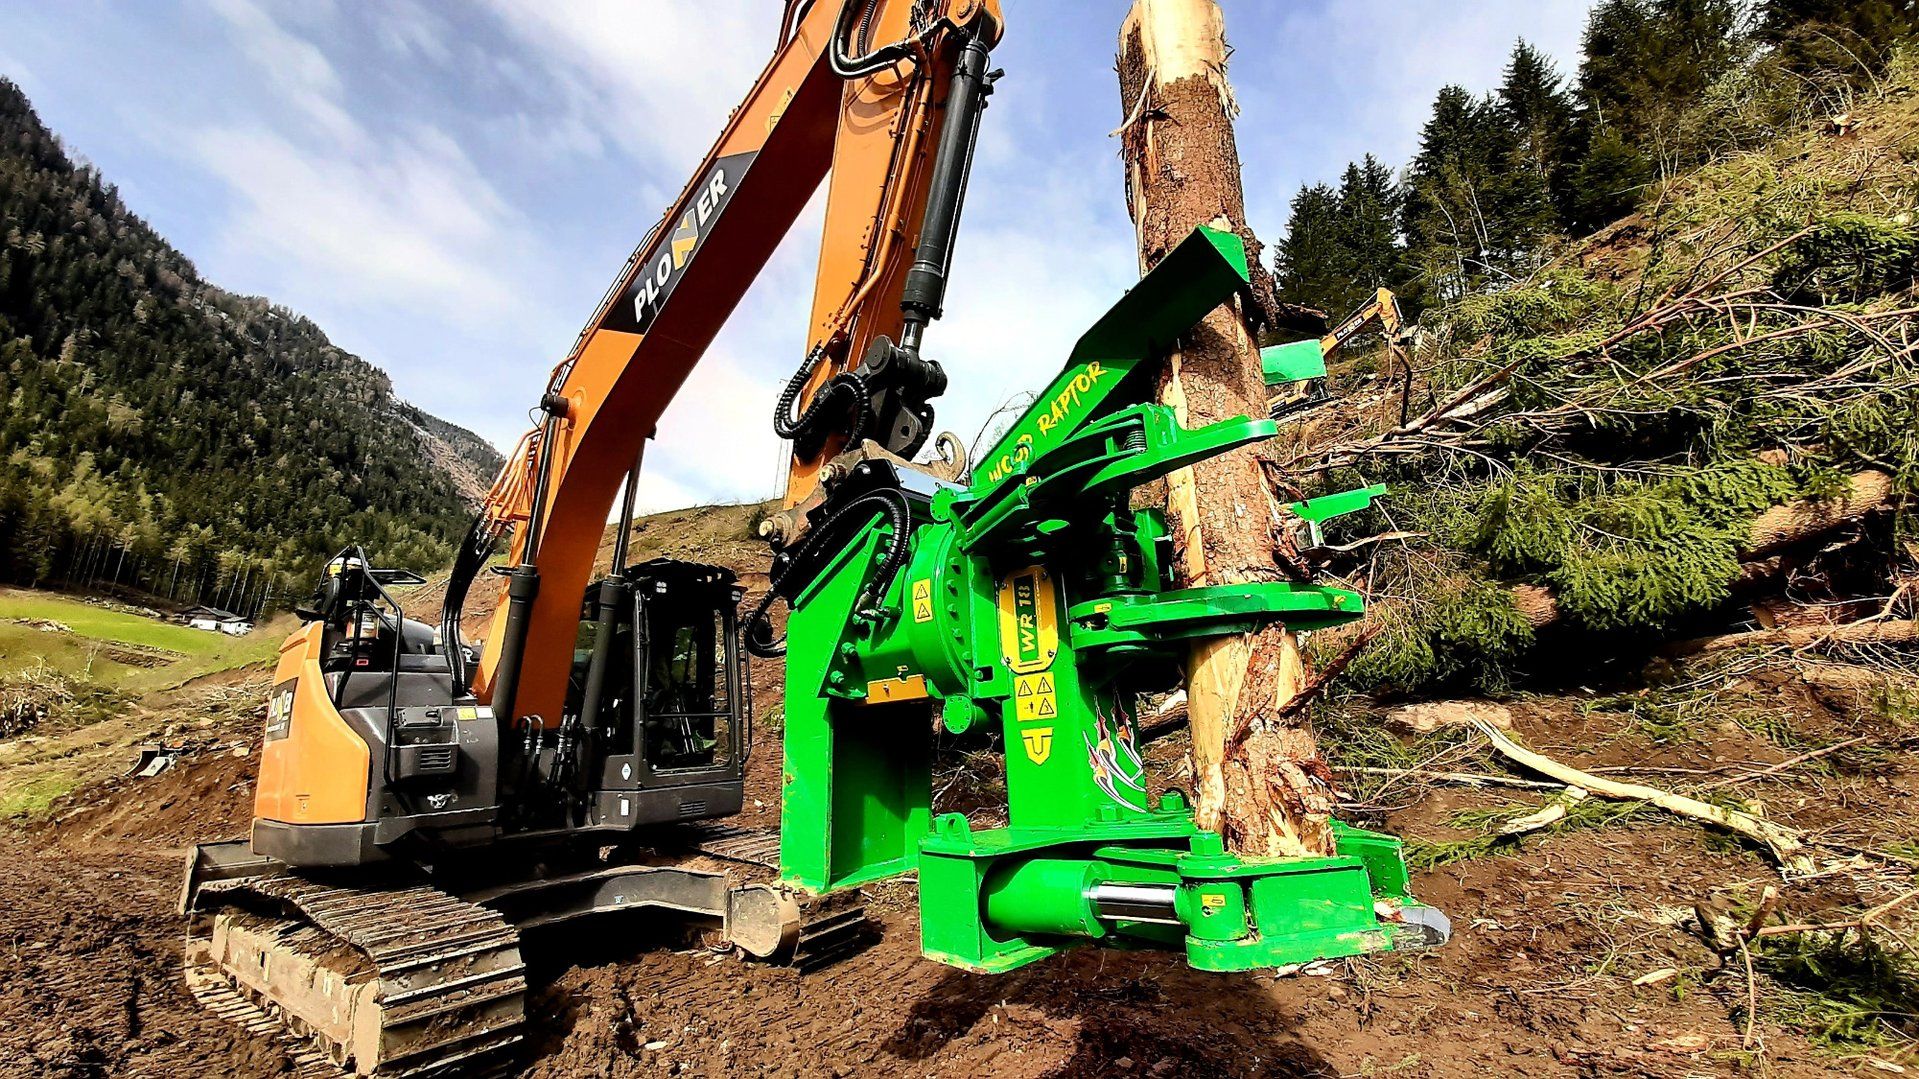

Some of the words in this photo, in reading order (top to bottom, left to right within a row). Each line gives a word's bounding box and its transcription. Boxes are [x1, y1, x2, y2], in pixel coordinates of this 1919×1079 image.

[1036, 360, 1108, 438] RAPTOR
[1018, 585, 1032, 607] 18
[1019, 613, 1036, 653] WR
